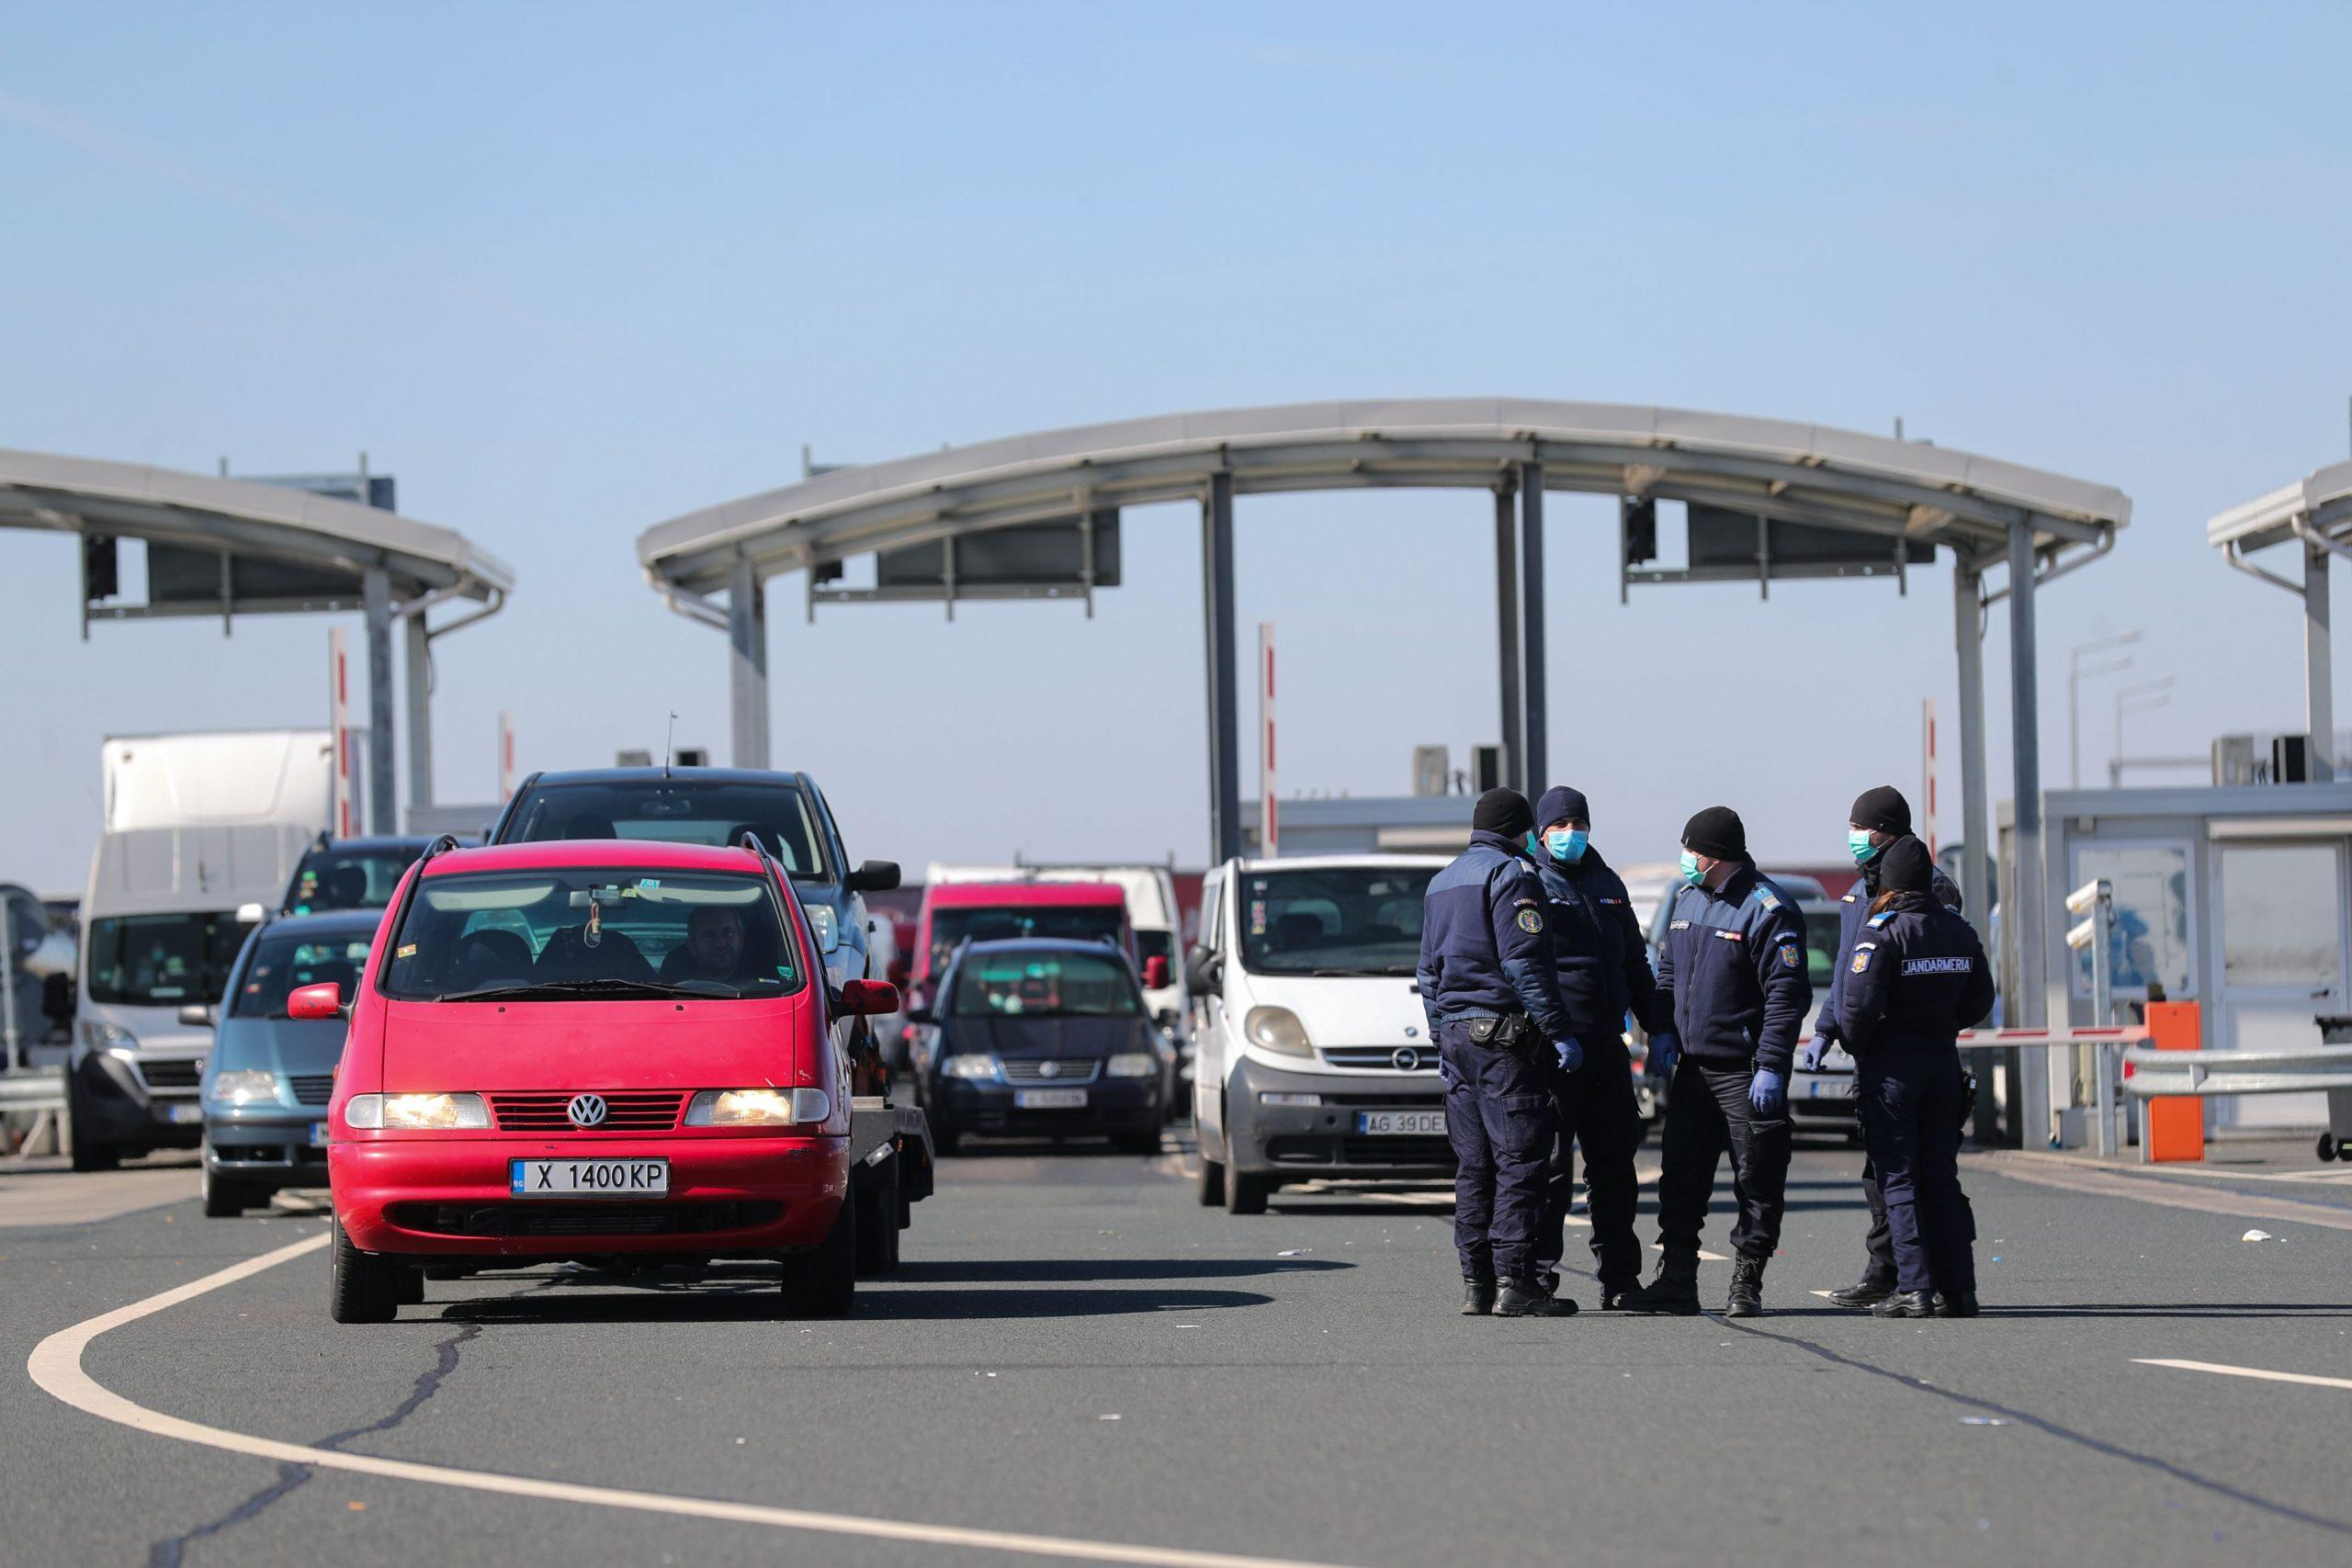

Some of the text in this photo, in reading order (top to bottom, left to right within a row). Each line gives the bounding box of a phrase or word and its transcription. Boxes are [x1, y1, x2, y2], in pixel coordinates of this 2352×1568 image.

[1904, 958, 1971, 974] JANDARMERIA
[1369, 1115, 1390, 1133] AG
[513, 1179, 525, 1188] BG
[537, 1164, 552, 1189] X
